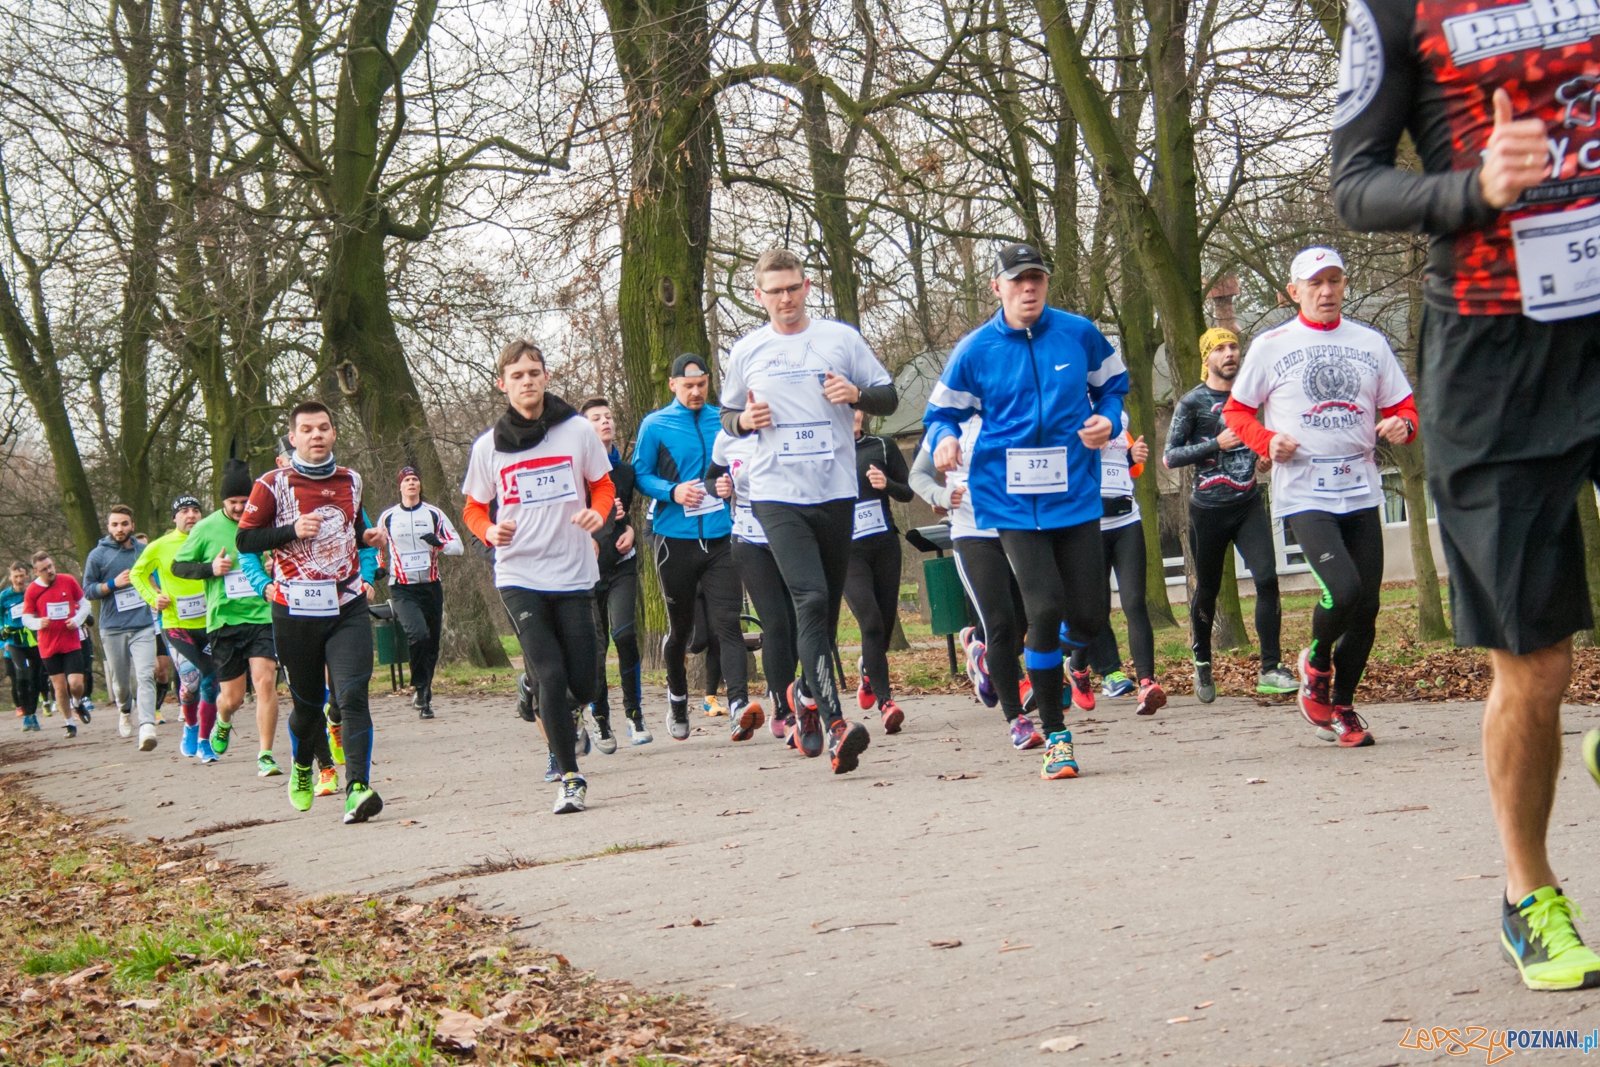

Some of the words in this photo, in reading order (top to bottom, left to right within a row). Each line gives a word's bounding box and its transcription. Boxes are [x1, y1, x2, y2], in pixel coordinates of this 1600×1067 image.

[1567, 236, 1600, 264] 56
[1273, 360, 1286, 378] VI
[1282, 348, 1305, 370] BIEG
[795, 429, 814, 440] 180
[1028, 459, 1048, 469] 372
[1106, 468, 1120, 477] 657
[1332, 464, 1351, 476] 356
[536, 475, 555, 487] 274
[858, 510, 873, 520] 655
[304, 589, 322, 598] 824
[188, 600, 201, 608] 279
